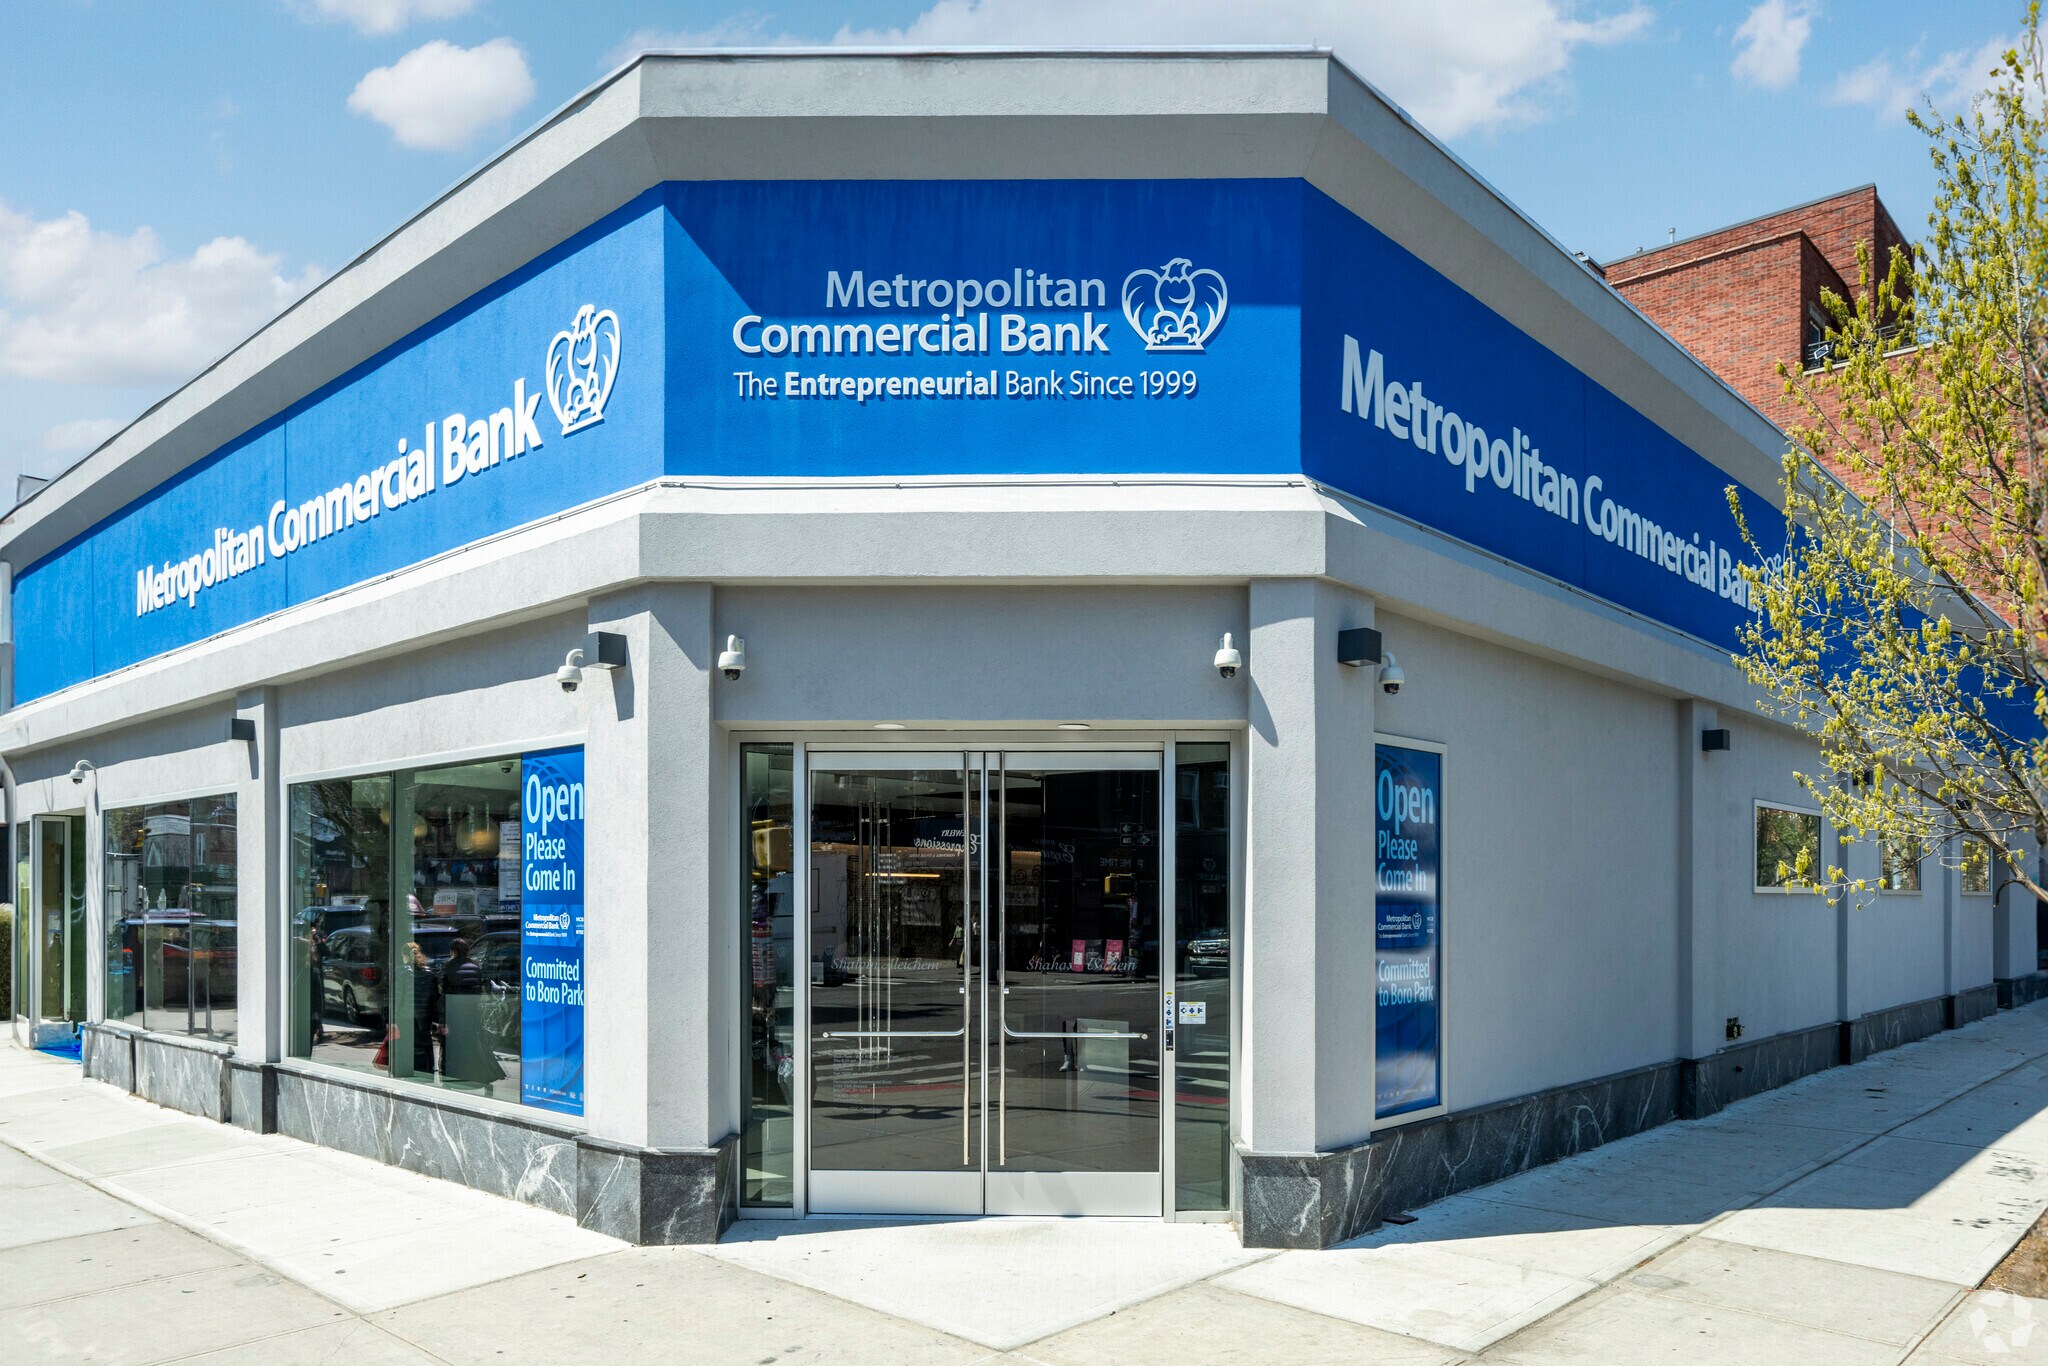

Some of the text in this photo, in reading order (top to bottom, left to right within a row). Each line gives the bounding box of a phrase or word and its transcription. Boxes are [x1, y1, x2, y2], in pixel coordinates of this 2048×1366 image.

[827, 268, 1106, 317] Metropolitan
[733, 312, 1110, 353] Commercial Bank
[733, 370, 1197, 402] The Entrepreneurial Bank Since 1999
[1341, 334, 1763, 616] Metropolitan Commercial Ban
[136, 377, 544, 617] Metropolitan Commercial Bank
[525, 774, 584, 836] Open
[1378, 769, 1434, 835] Open
[526, 832, 566, 860] Please
[1379, 830, 1417, 860] Please
[526, 862, 576, 891] Come In
[1378, 862, 1427, 892] Come In
[525, 921, 560, 930] Commercial Bank
[533, 914, 559, 924] Metropolitan
[1378, 922, 1412, 931] Commercial Bank
[1386, 914, 1412, 923] Metropolitan
[526, 957, 580, 981] Committed
[881, 957, 940, 970] Aleichem
[1378, 957, 1430, 982] Committed
[526, 981, 584, 1006] to Boro Park
[1379, 980, 1434, 1006] to Boro Park
